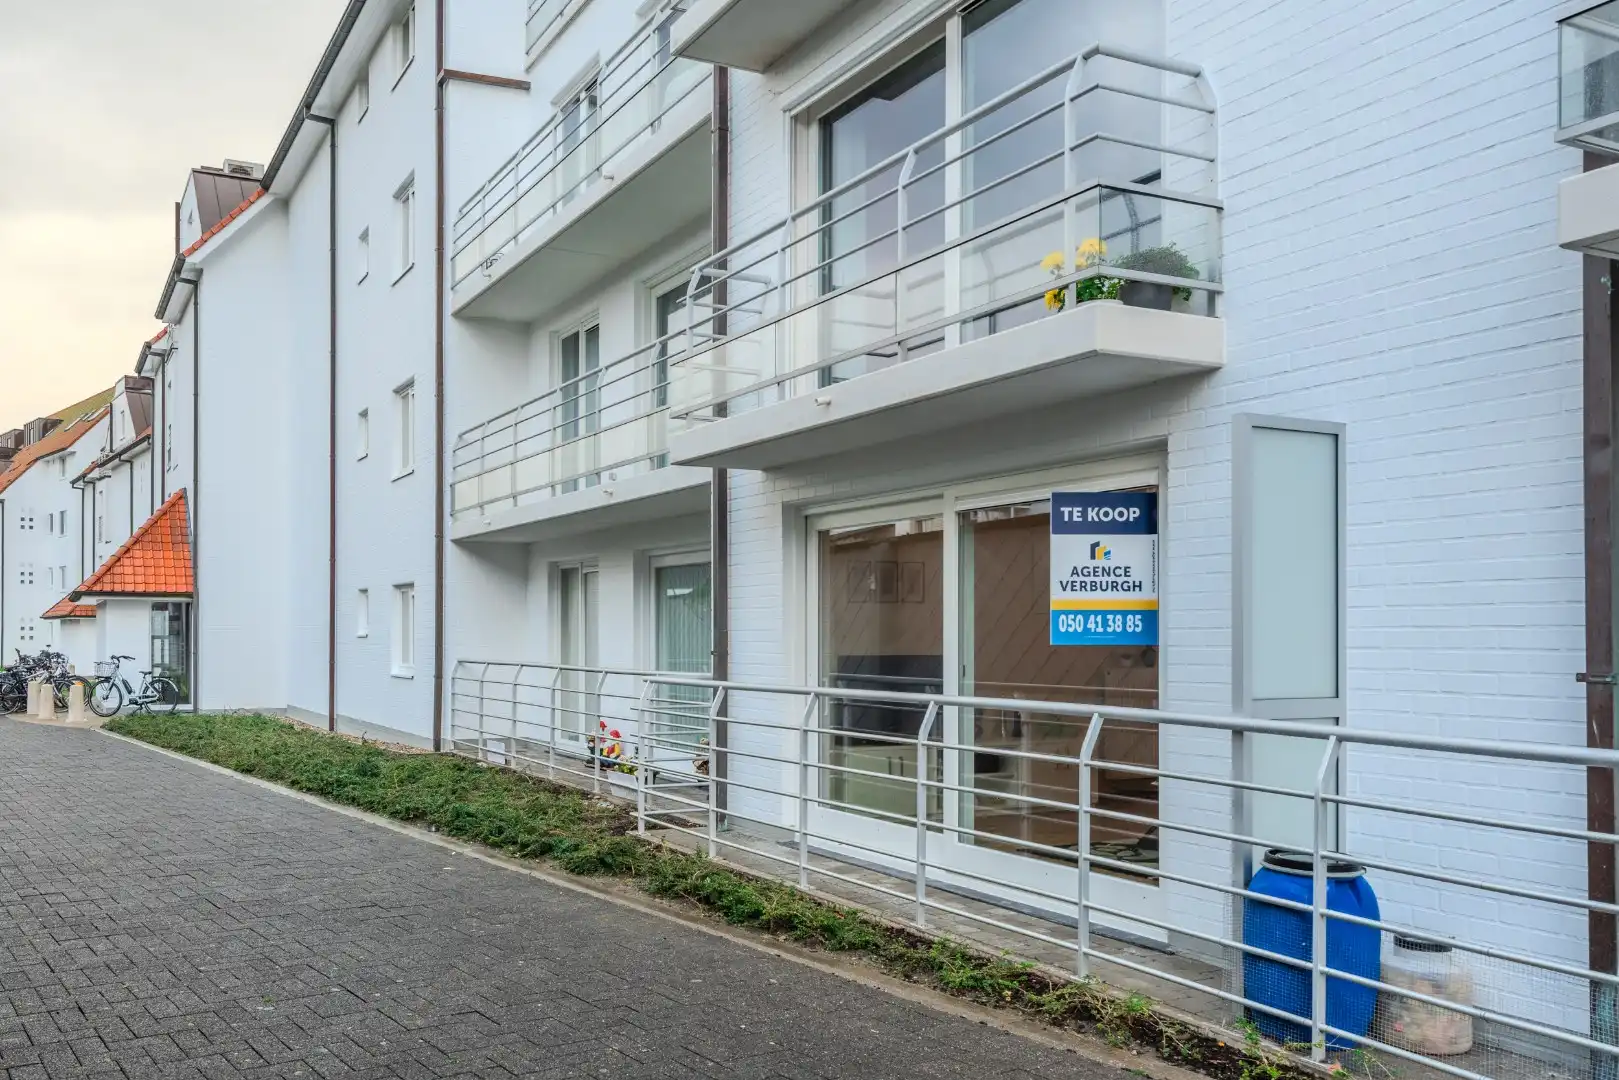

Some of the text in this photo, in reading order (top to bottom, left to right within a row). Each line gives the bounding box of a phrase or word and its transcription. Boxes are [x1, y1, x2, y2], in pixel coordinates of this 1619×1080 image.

[1060, 507, 1140, 522] TE KOOP
[1070, 566, 1132, 577] AGENCE
[1059, 580, 1142, 592] VERBURGH
[1058, 614, 1142, 632] 050 41 38 85
